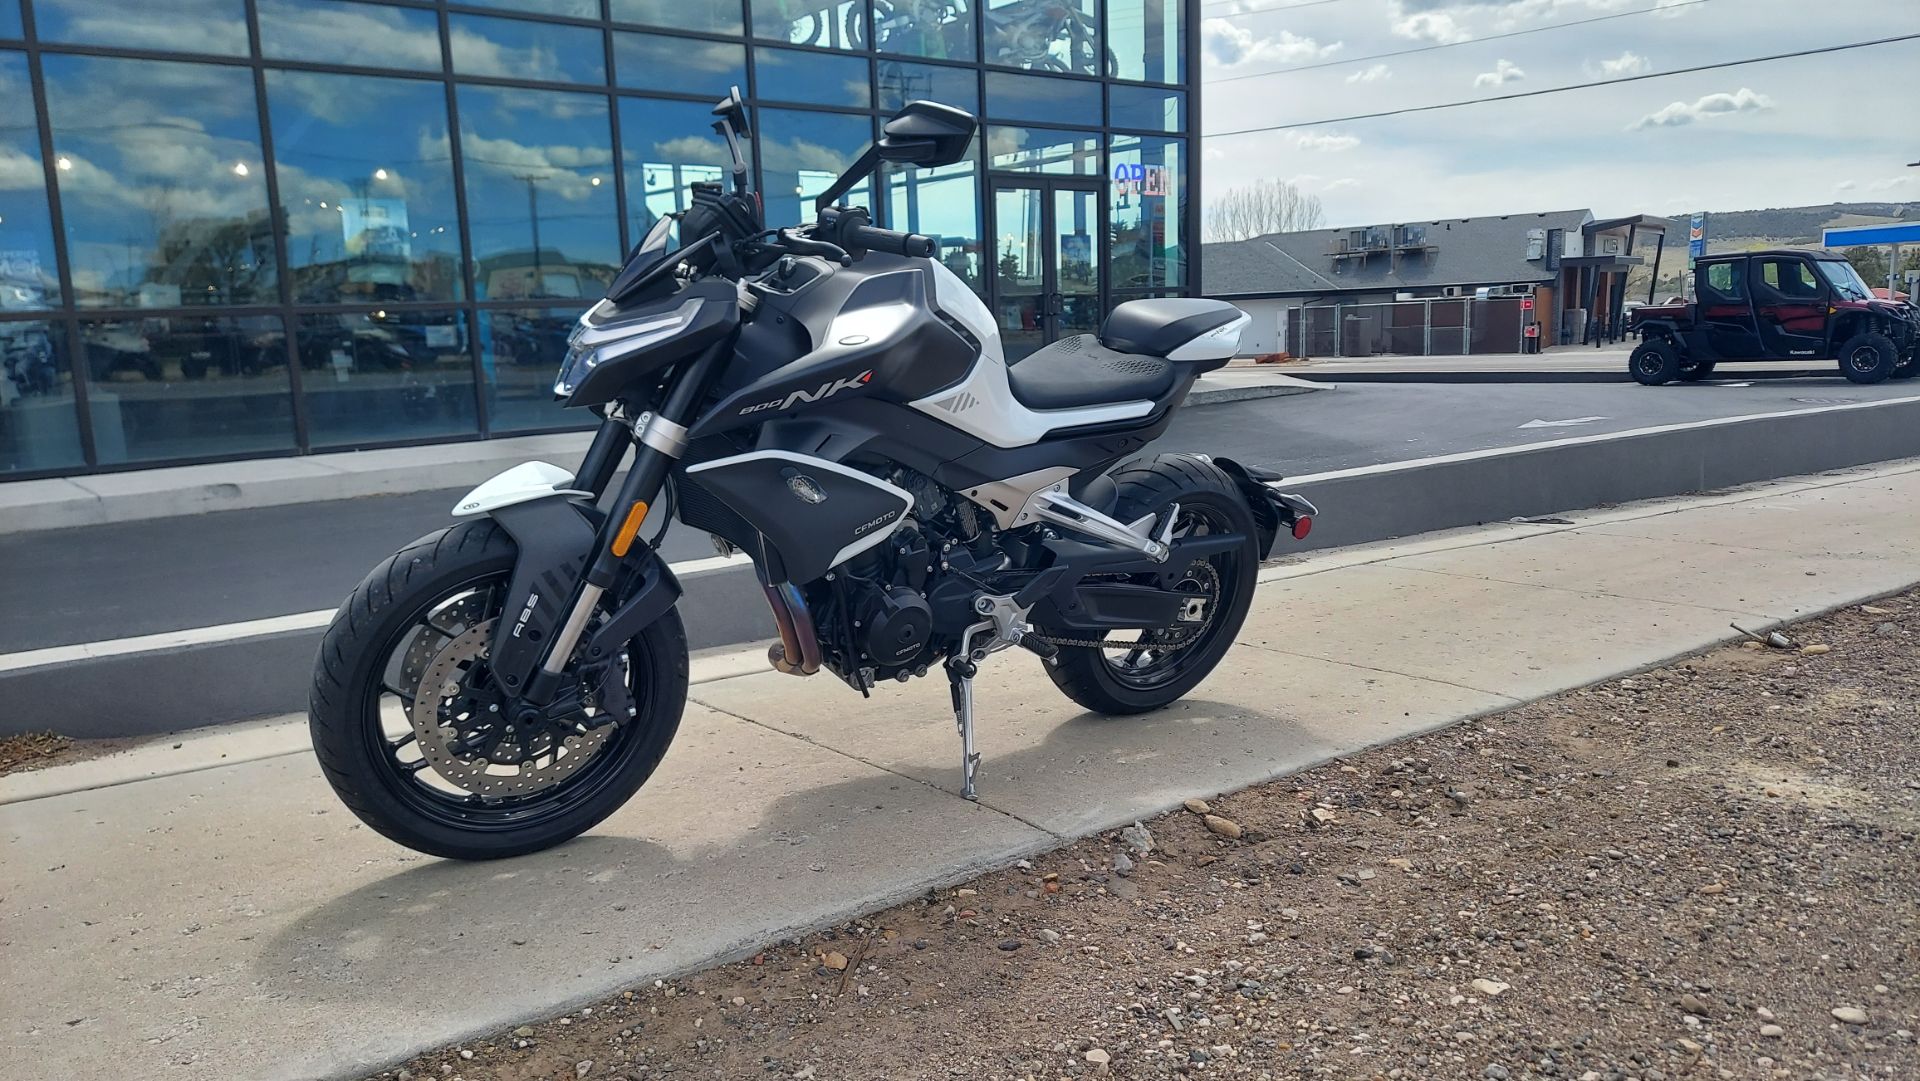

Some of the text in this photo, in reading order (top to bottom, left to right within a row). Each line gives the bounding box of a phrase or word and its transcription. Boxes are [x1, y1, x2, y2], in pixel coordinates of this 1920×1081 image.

[1113, 163, 1172, 196] OPEN
[855, 510, 895, 535] CFMOTO
[513, 593, 539, 637] ABS
[896, 642, 921, 656] CFMOTO
